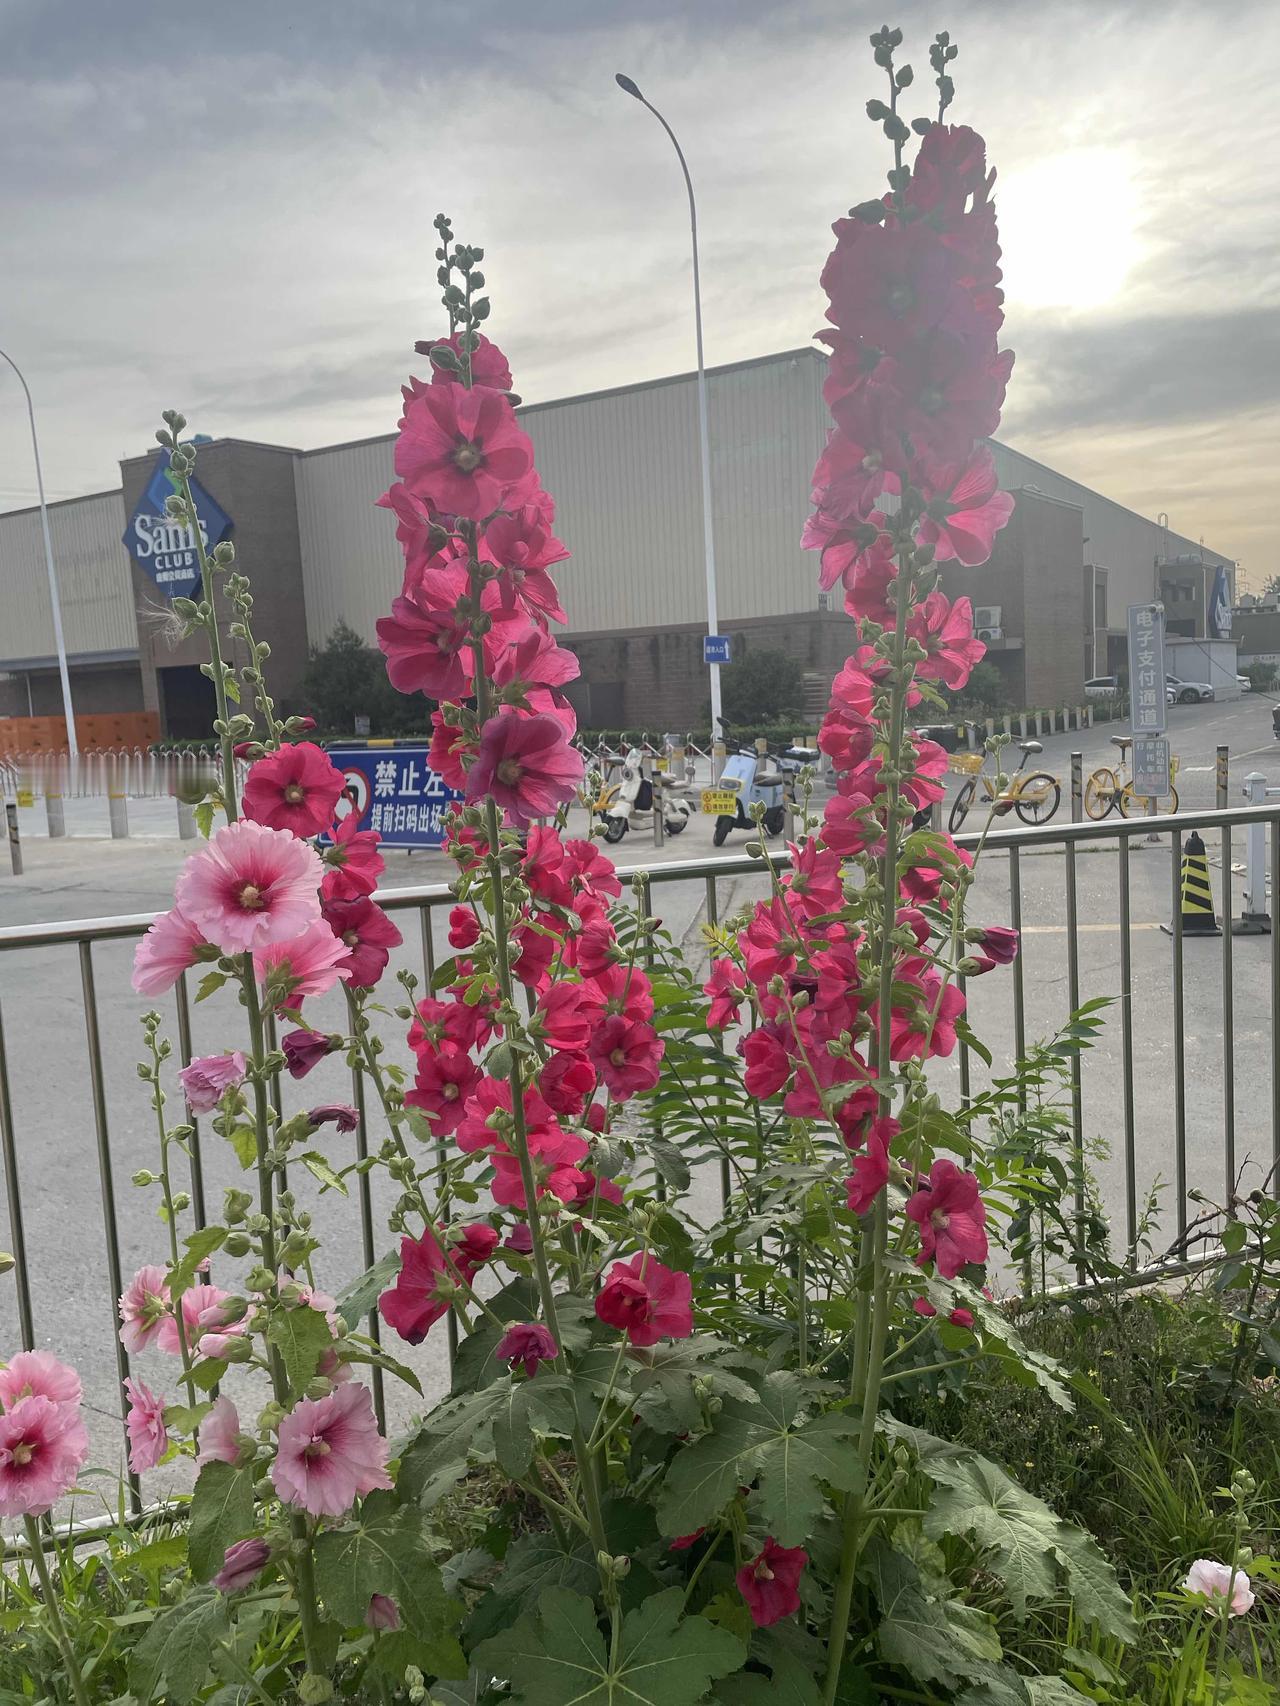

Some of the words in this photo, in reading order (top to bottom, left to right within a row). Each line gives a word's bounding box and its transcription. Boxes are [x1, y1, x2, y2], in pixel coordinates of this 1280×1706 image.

[155, 552, 193, 569] CLUB
[1136, 610, 1158, 726] 电子支付通道
[374, 760, 463, 798] 禁止左
[371, 803, 449, 833] 提前扫码出场
